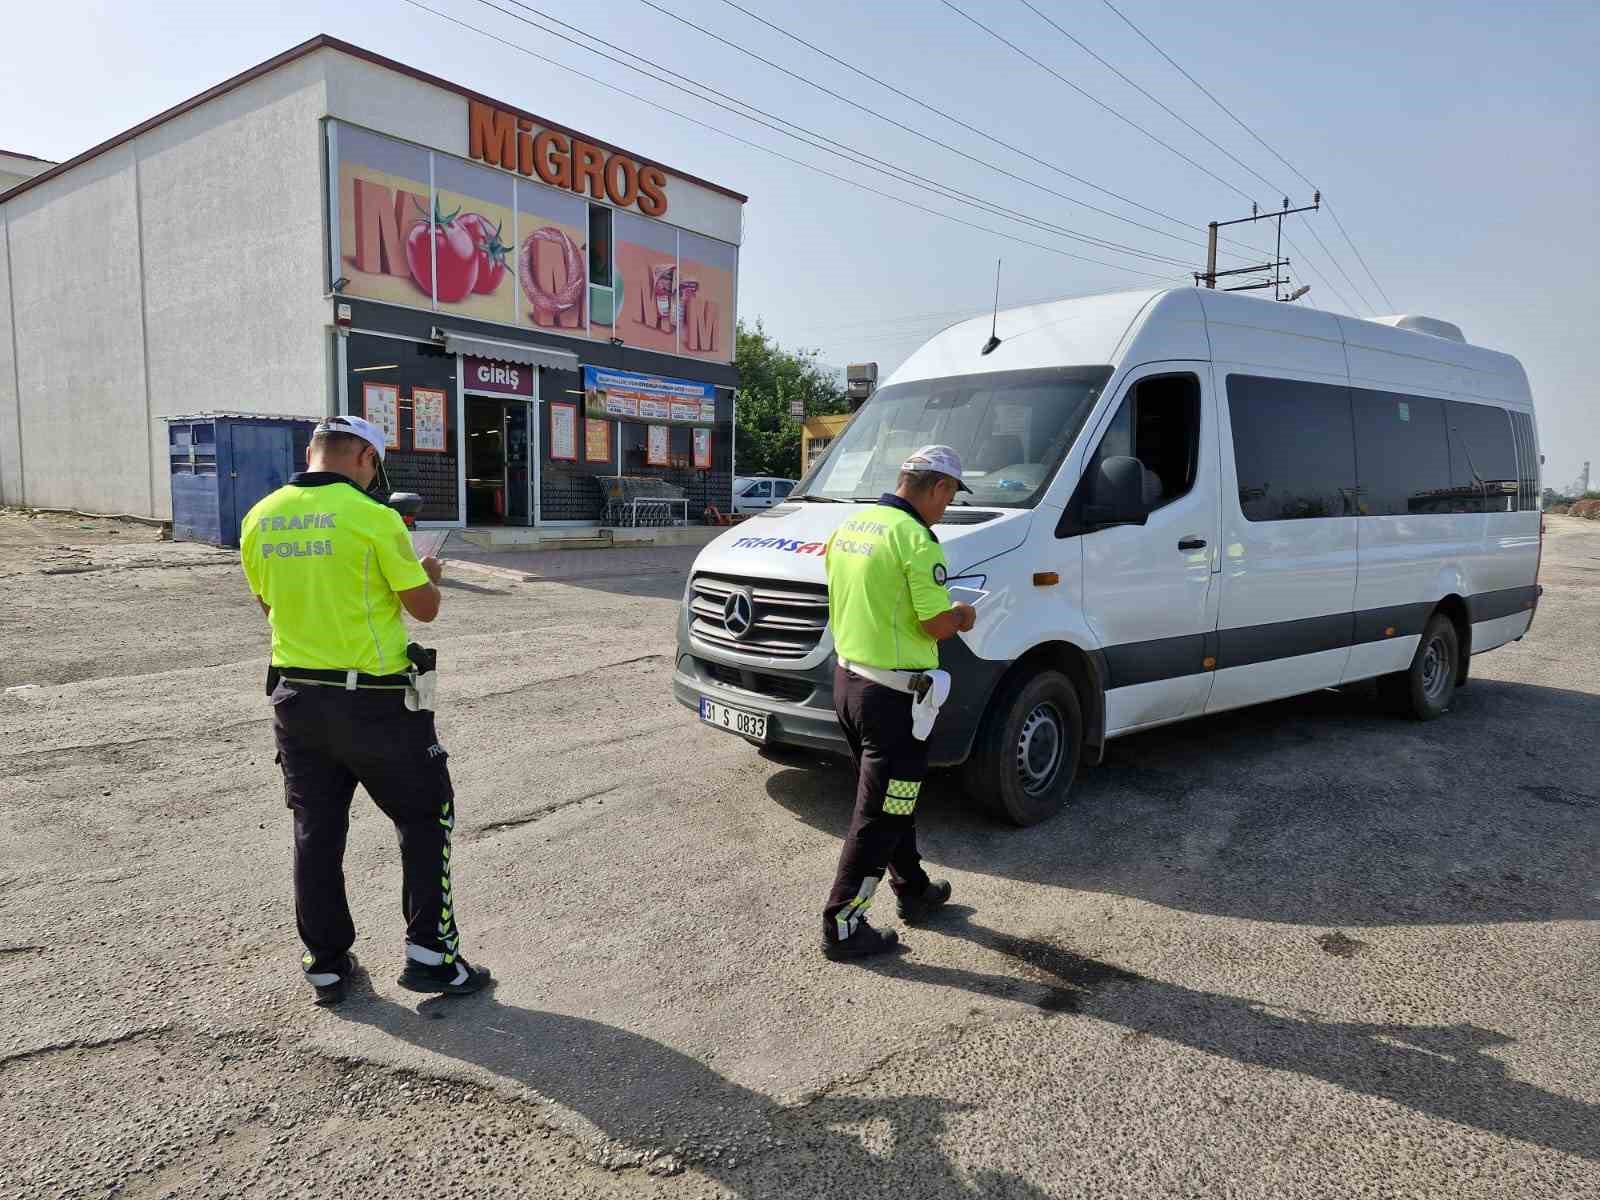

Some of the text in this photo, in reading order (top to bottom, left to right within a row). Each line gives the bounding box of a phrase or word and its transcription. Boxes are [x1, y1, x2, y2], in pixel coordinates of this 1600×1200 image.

[477, 363, 519, 390] GİRİŞ
[706, 702, 765, 737] 31 S 0833
